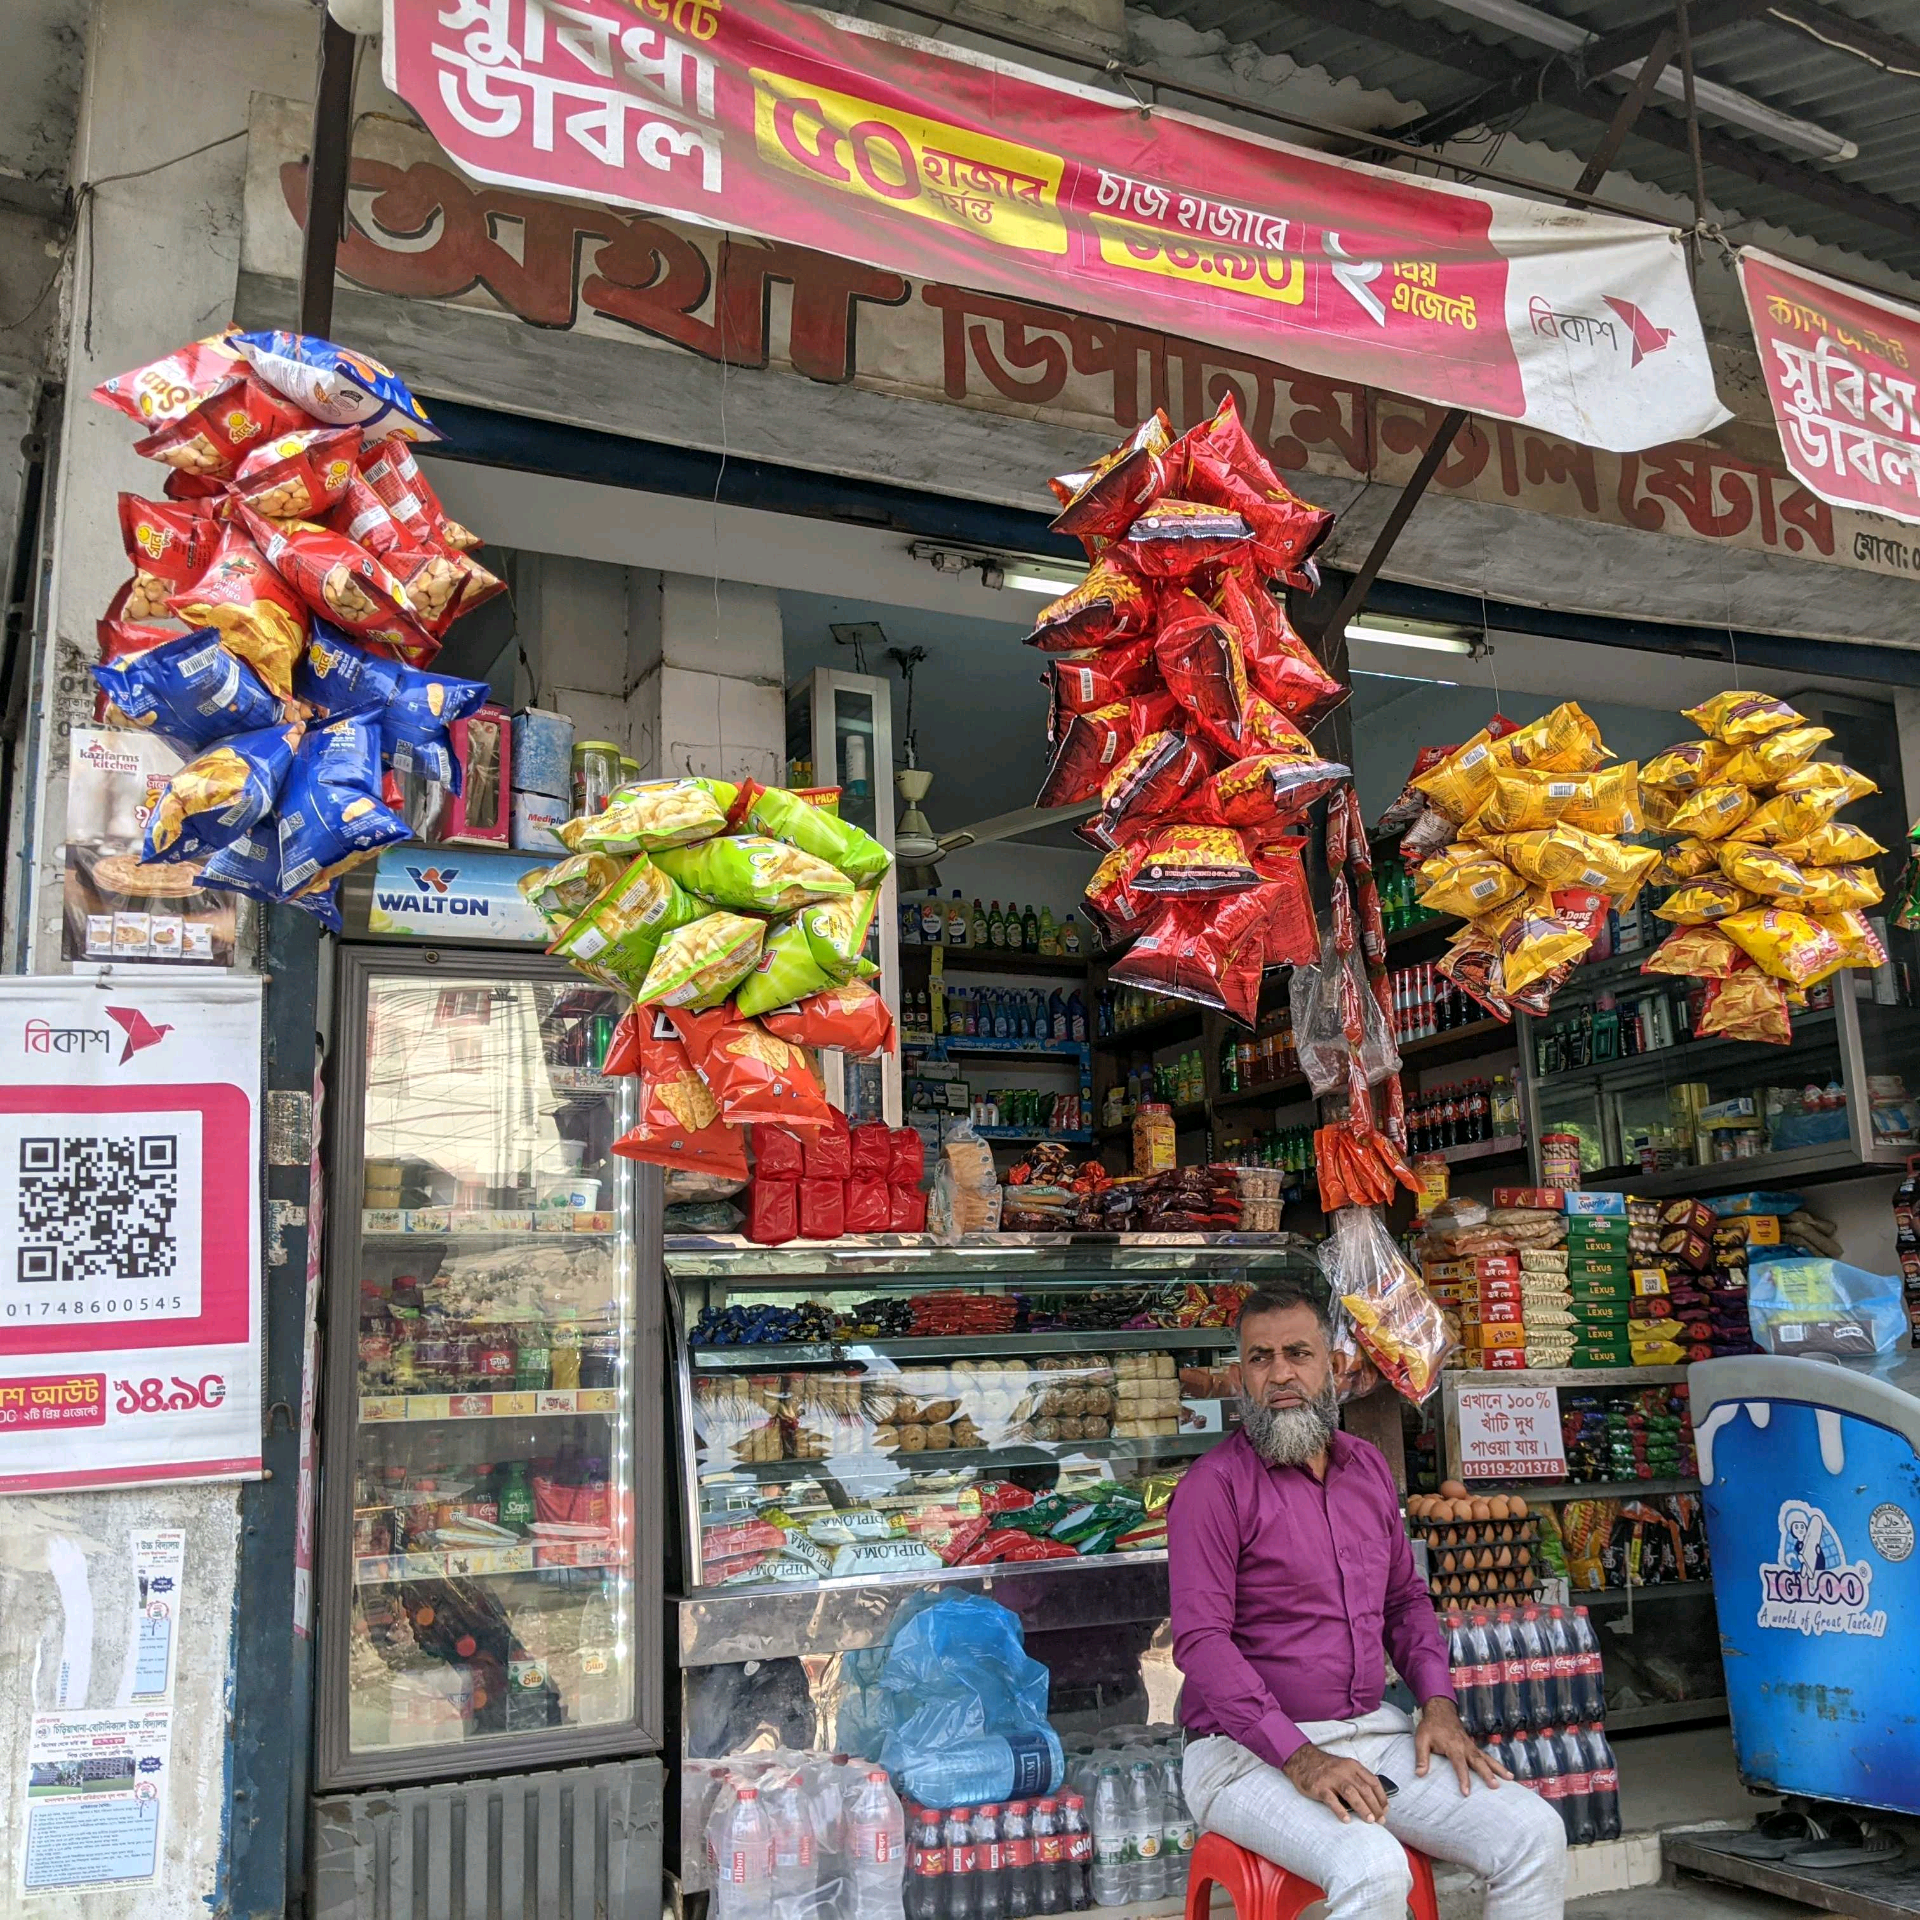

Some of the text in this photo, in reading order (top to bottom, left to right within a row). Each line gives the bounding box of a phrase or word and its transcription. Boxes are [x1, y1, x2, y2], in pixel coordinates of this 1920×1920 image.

[431, 42, 725, 194] ডাবল
[773, 97, 1049, 209] ৫০ হাজার
[1391, 284, 1478, 331] এজেন্টে
[1528, 295, 1618, 351] বিকাশ
[92, 759, 138, 772] kitchen
[815, 791, 839, 805] PACK
[377, 893, 490, 917] WALTON
[24, 1018, 111, 1055] বিকাশ
[1586, 1243, 1612, 1251] LEXUS
[1586, 1265, 1612, 1273] LEXUS
[1589, 1287, 1615, 1295] LEXUS
[6, 1295, 182, 1318] 01748600545
[1587, 1330, 1614, 1338] LEXUS
[1589, 1353, 1616, 1361] LEXUS
[30, 1379, 99, 1406] আউট
[1461, 1392, 1503, 1409] এখানে
[1481, 1412, 1535, 1437] খাঁটি দুধ
[1470, 1440, 1511, 1457] পাওয়া
[1514, 1440, 1539, 1456] যায়
[1464, 1461, 1560, 1476] 01919-201378
[820, 1514, 885, 1526] DIPLOMA
[853, 1542, 927, 1560] DIPLOMA
[1764, 1569, 1865, 1606] IGLOO
[1760, 1607, 1768, 1622] A
[1771, 1609, 1796, 1625] world
[1801, 1611, 1810, 1631] of
[1814, 1611, 1842, 1628] Great
[1025, 1760, 1036, 1790] MUM
